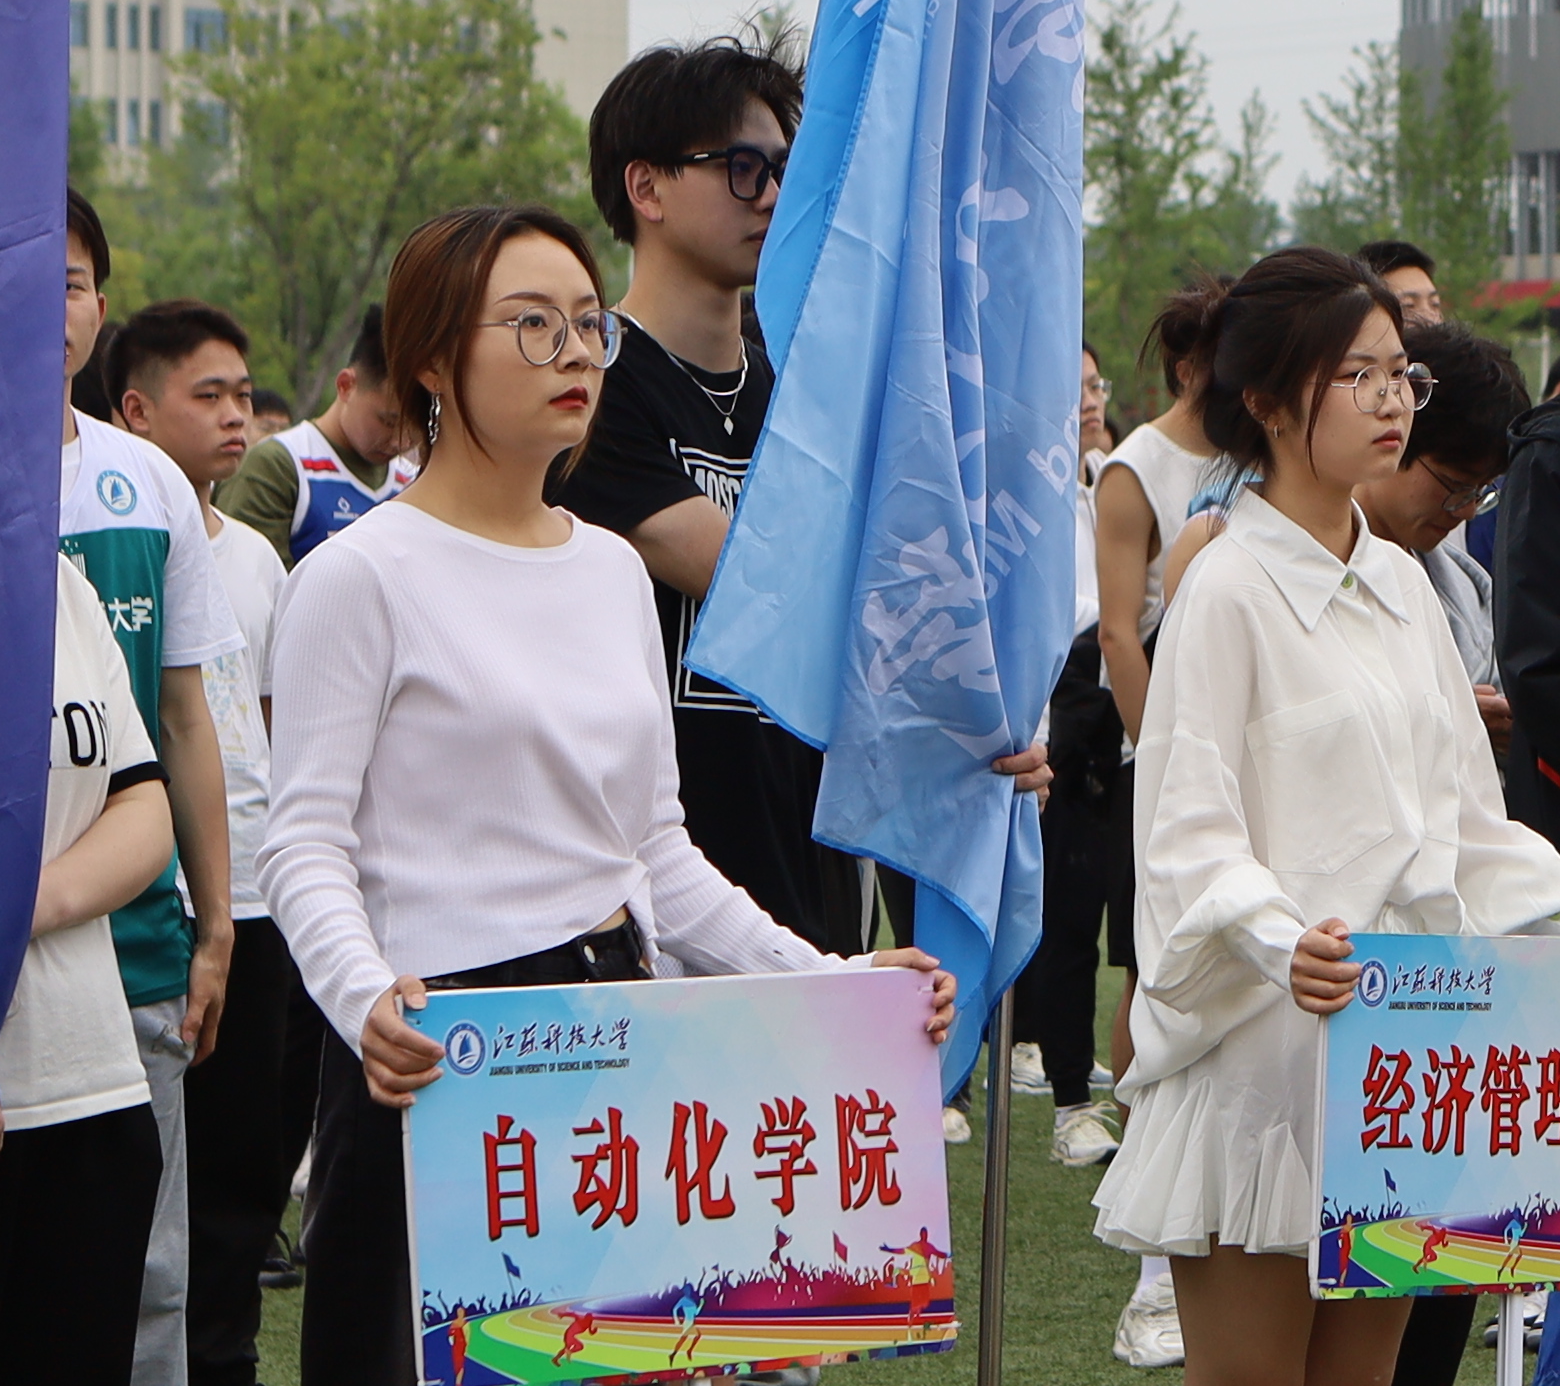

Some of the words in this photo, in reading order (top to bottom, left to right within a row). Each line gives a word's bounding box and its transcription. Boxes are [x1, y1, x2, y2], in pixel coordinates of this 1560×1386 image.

[483, 1088, 902, 1241] 自动化学院
